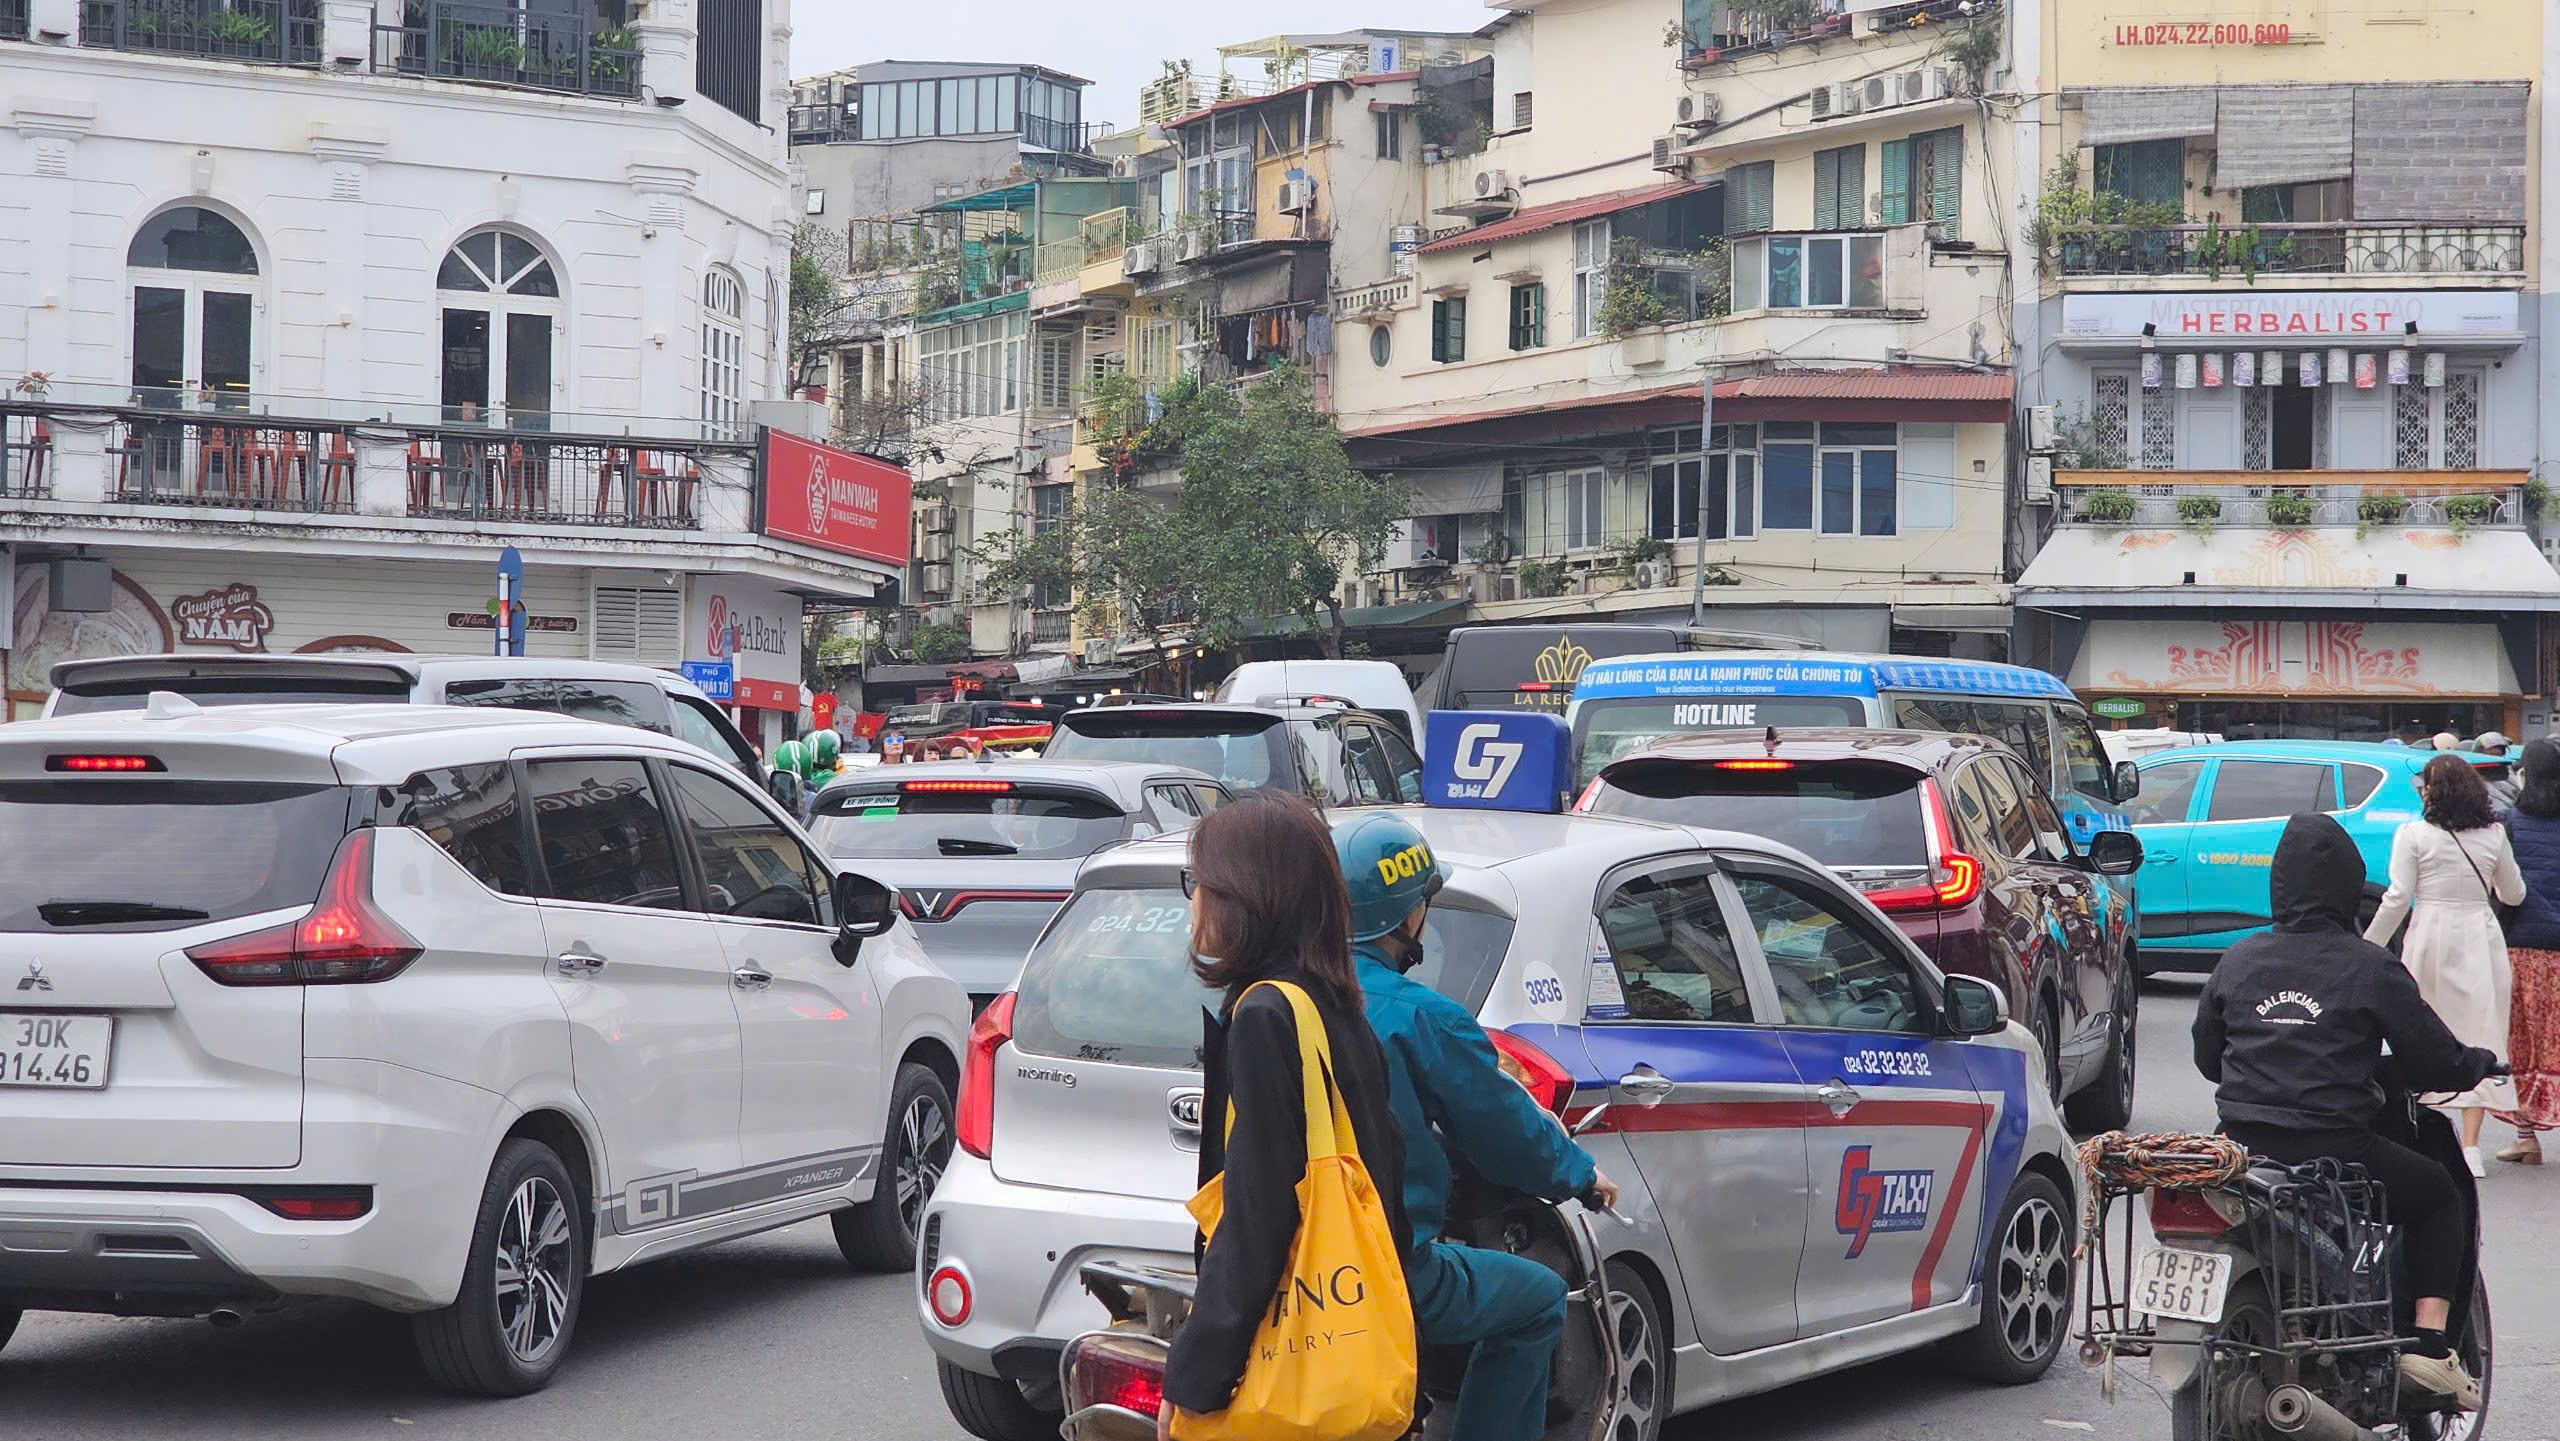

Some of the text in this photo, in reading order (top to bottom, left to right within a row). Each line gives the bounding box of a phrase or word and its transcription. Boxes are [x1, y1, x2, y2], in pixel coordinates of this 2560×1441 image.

[2182, 312, 2392, 333] HERBALIST
[831, 477, 878, 513] MANWAH
[179, 595, 225, 616] Chuyện
[187, 608, 251, 641] NẤM
[702, 667, 719, 676] PHỐ
[1580, 672, 1597, 688] SỰ
[1597, 670, 1615, 685] HÀI
[1616, 667, 1643, 683] LÒNG
[1645, 665, 1667, 682] CỦA
[1669, 668, 1693, 684] BẠN
[1694, 666, 1709, 681] LÀ
[1710, 667, 1741, 684] HẠNH
[1742, 665, 1773, 681] PHÚC
[1775, 664, 1799, 681] CỦA
[1801, 666, 1841, 682] CHÚNG
[1843, 667, 1863, 683] TÔI
[1513, 693, 1533, 705] LA
[1655, 685, 1671, 694] Your
[1672, 685, 1713, 693] Satisfaction
[1715, 685, 1721, 693] is
[1736, 685, 1776, 695] Happiness
[1673, 704, 1757, 726] HOTLINE
[2097, 703, 2140, 713] HERBALIST
[1453, 723, 1524, 798] G7
[1377, 844, 1431, 886] DQTV
[2209, 853, 2238, 865] 1900
[1525, 976, 1562, 1005] 3836
[2255, 990, 2323, 1018] BALENCIAGA
[16, 1018, 72, 1049] 30K
[1843, 1056, 1863, 1073] 024
[1017, 1066, 1077, 1088] morning
[1178, 1101, 1199, 1121] KI
[783, 1167, 844, 1190] XPANDER
[625, 1169, 698, 1227] GT
[1883, 1175, 1932, 1214] TAXI
[2156, 1252, 2217, 1284] 18-P3
[2146, 1280, 2209, 1315] 5561
